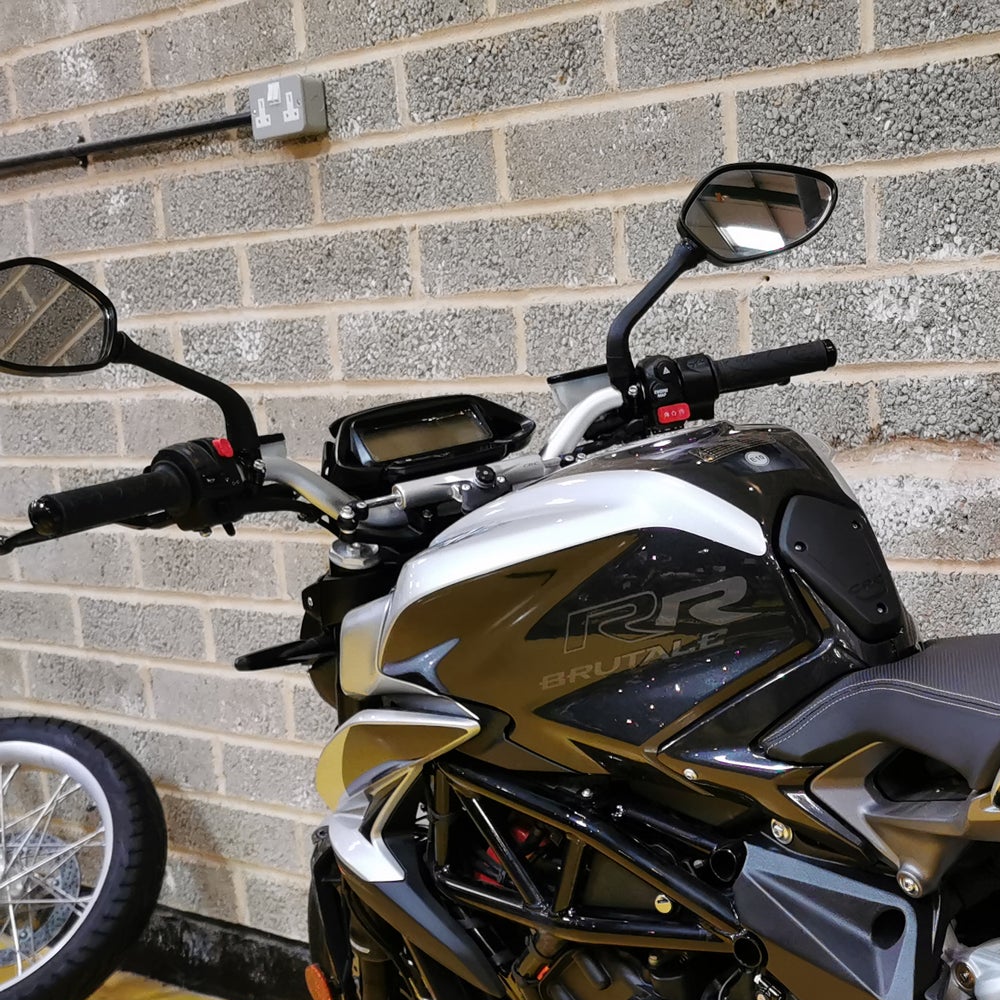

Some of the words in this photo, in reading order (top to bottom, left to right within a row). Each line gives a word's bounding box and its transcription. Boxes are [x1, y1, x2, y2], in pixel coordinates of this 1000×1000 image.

[750, 454, 766, 463] E10
[563, 576, 760, 655] RR
[539, 628, 728, 690] BRUTALE
